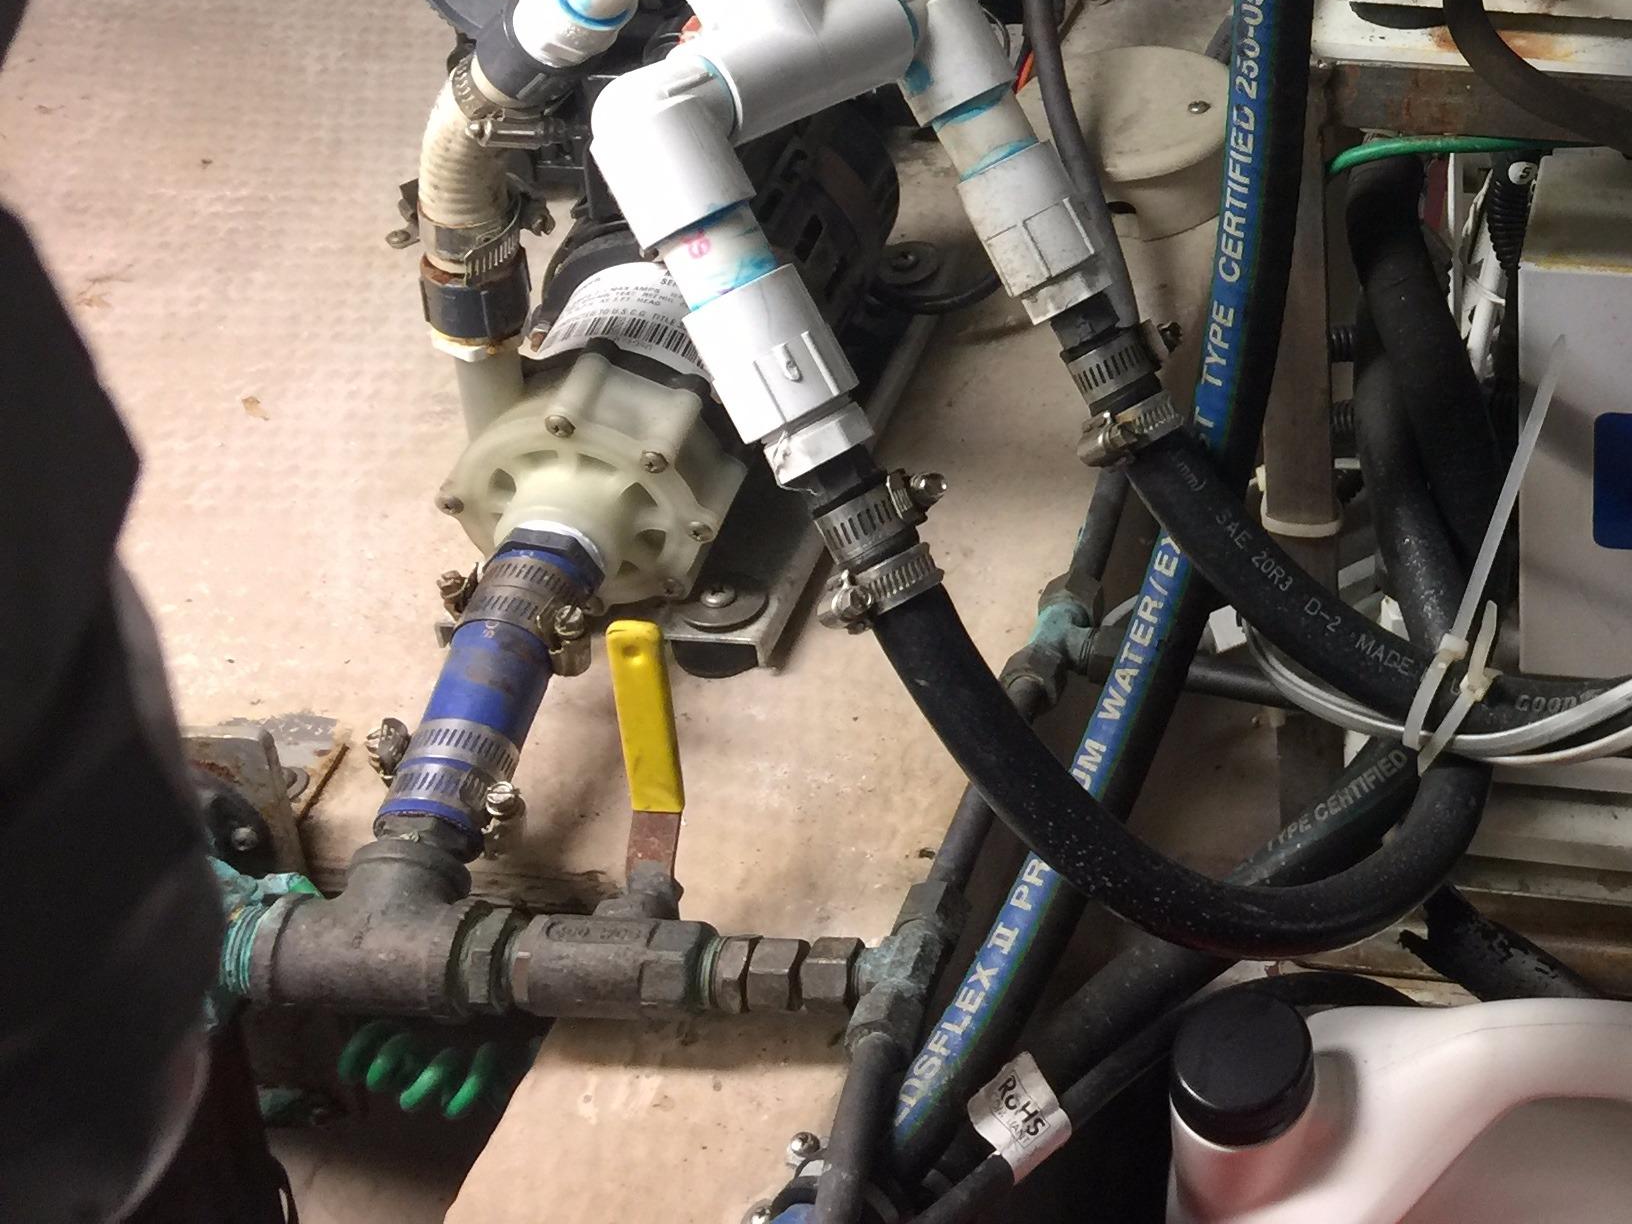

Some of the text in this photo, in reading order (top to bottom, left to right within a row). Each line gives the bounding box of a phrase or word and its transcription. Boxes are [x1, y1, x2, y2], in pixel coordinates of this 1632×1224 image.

[1217, 103, 1257, 284] CERTIFIED
[1201, 301, 1237, 387] TYPE
[1215, 512, 1415, 676] SAE 20R3 D-2 MADE
[1314, 752, 1408, 822] CERTIFIED
